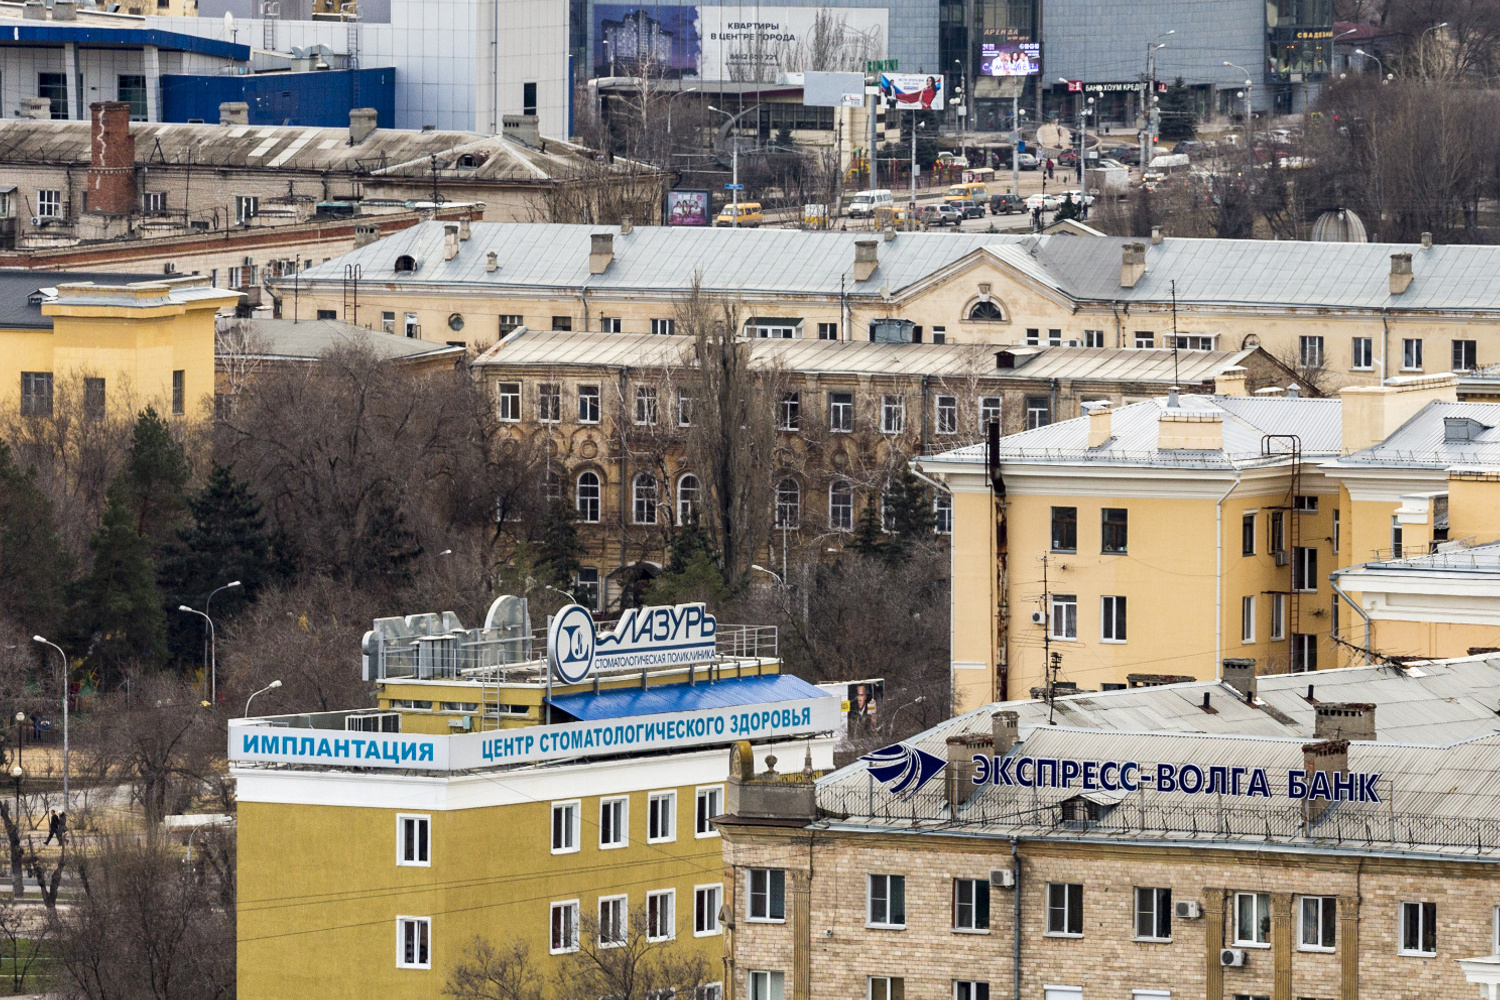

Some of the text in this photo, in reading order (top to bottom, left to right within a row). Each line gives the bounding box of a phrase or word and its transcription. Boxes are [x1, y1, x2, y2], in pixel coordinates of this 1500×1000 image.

[719, 33, 755, 41] ЦЕНТРЕ
[728, 22, 779, 30] КВАРТИРЫ
[1123, 82, 1148, 91] КРЕДТ
[617, 605, 717, 644] ЛАЗУРЬ
[595, 650, 715, 669] СТОМАТОЛОГИЧЕСКАЯ ПОЛИКЛИНИКА
[482, 706, 811, 762] ЦЕНТР СТОМАТОЛОГИЧЕСКОГО ЗДОРОВЬЯ
[243, 734, 434, 764] ИМПЛАНТАЦИЯ
[971, 754, 1382, 803] ЭКСПРЕСС-ВОЛГА БАНК
